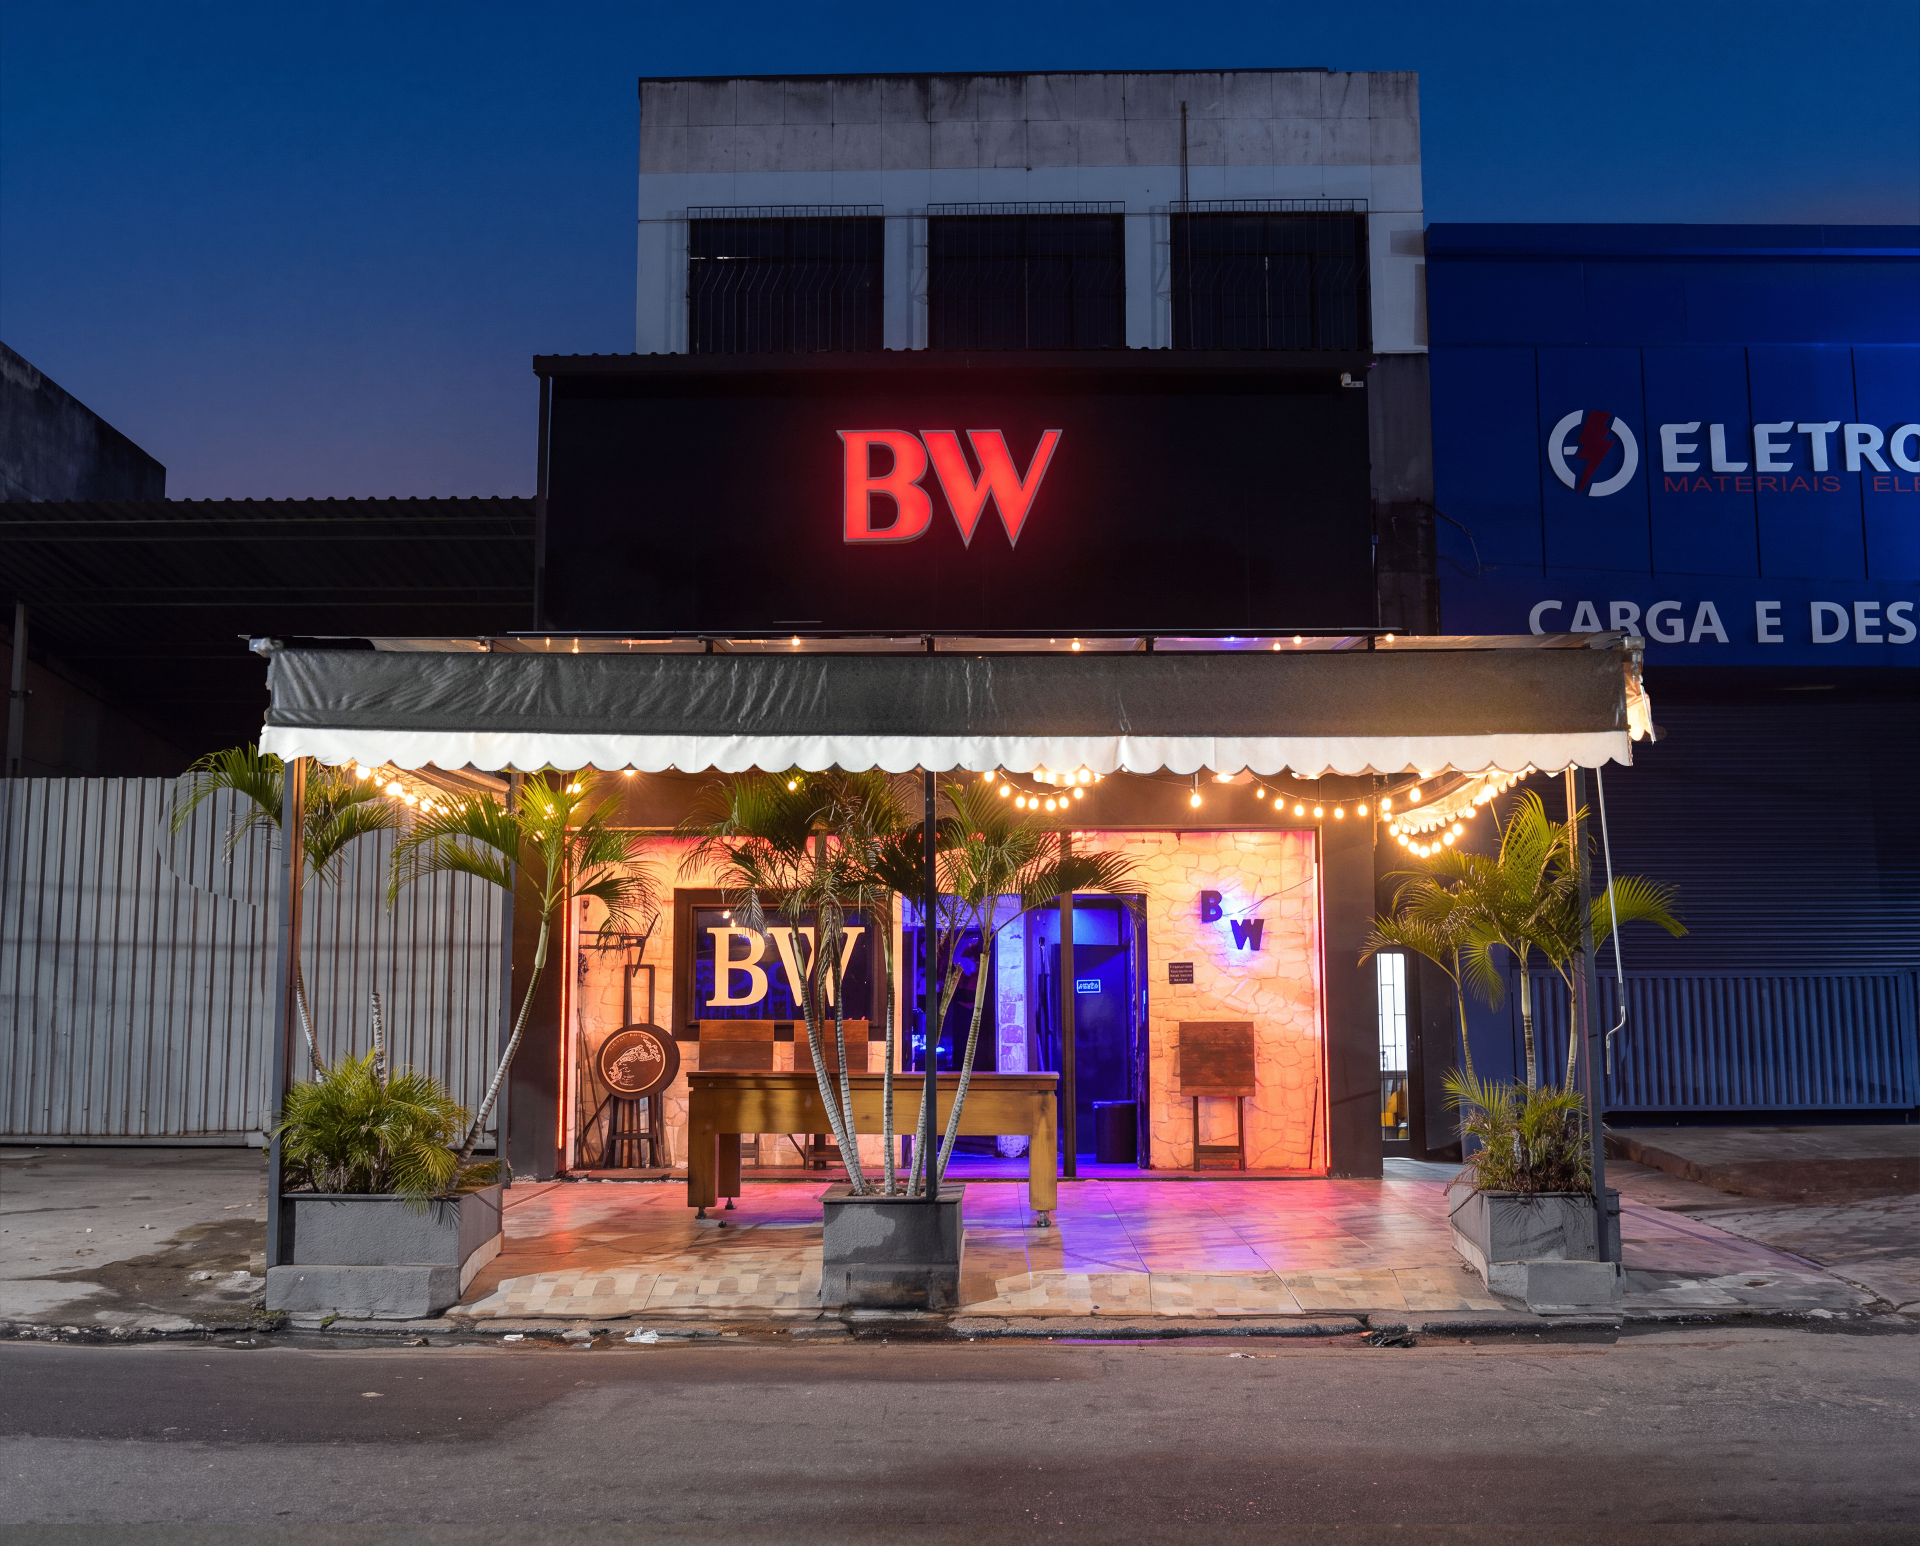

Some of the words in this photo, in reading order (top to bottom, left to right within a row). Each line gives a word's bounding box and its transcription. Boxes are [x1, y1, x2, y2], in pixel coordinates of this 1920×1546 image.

[1660, 421, 1920, 473] ELETRO
[836, 429, 1063, 550] BW
[1664, 476, 1841, 492] MATERIAIS
[1529, 600, 1730, 644] CARGA
[1756, 601, 1784, 643] E
[706, 927, 865, 1007] BW
